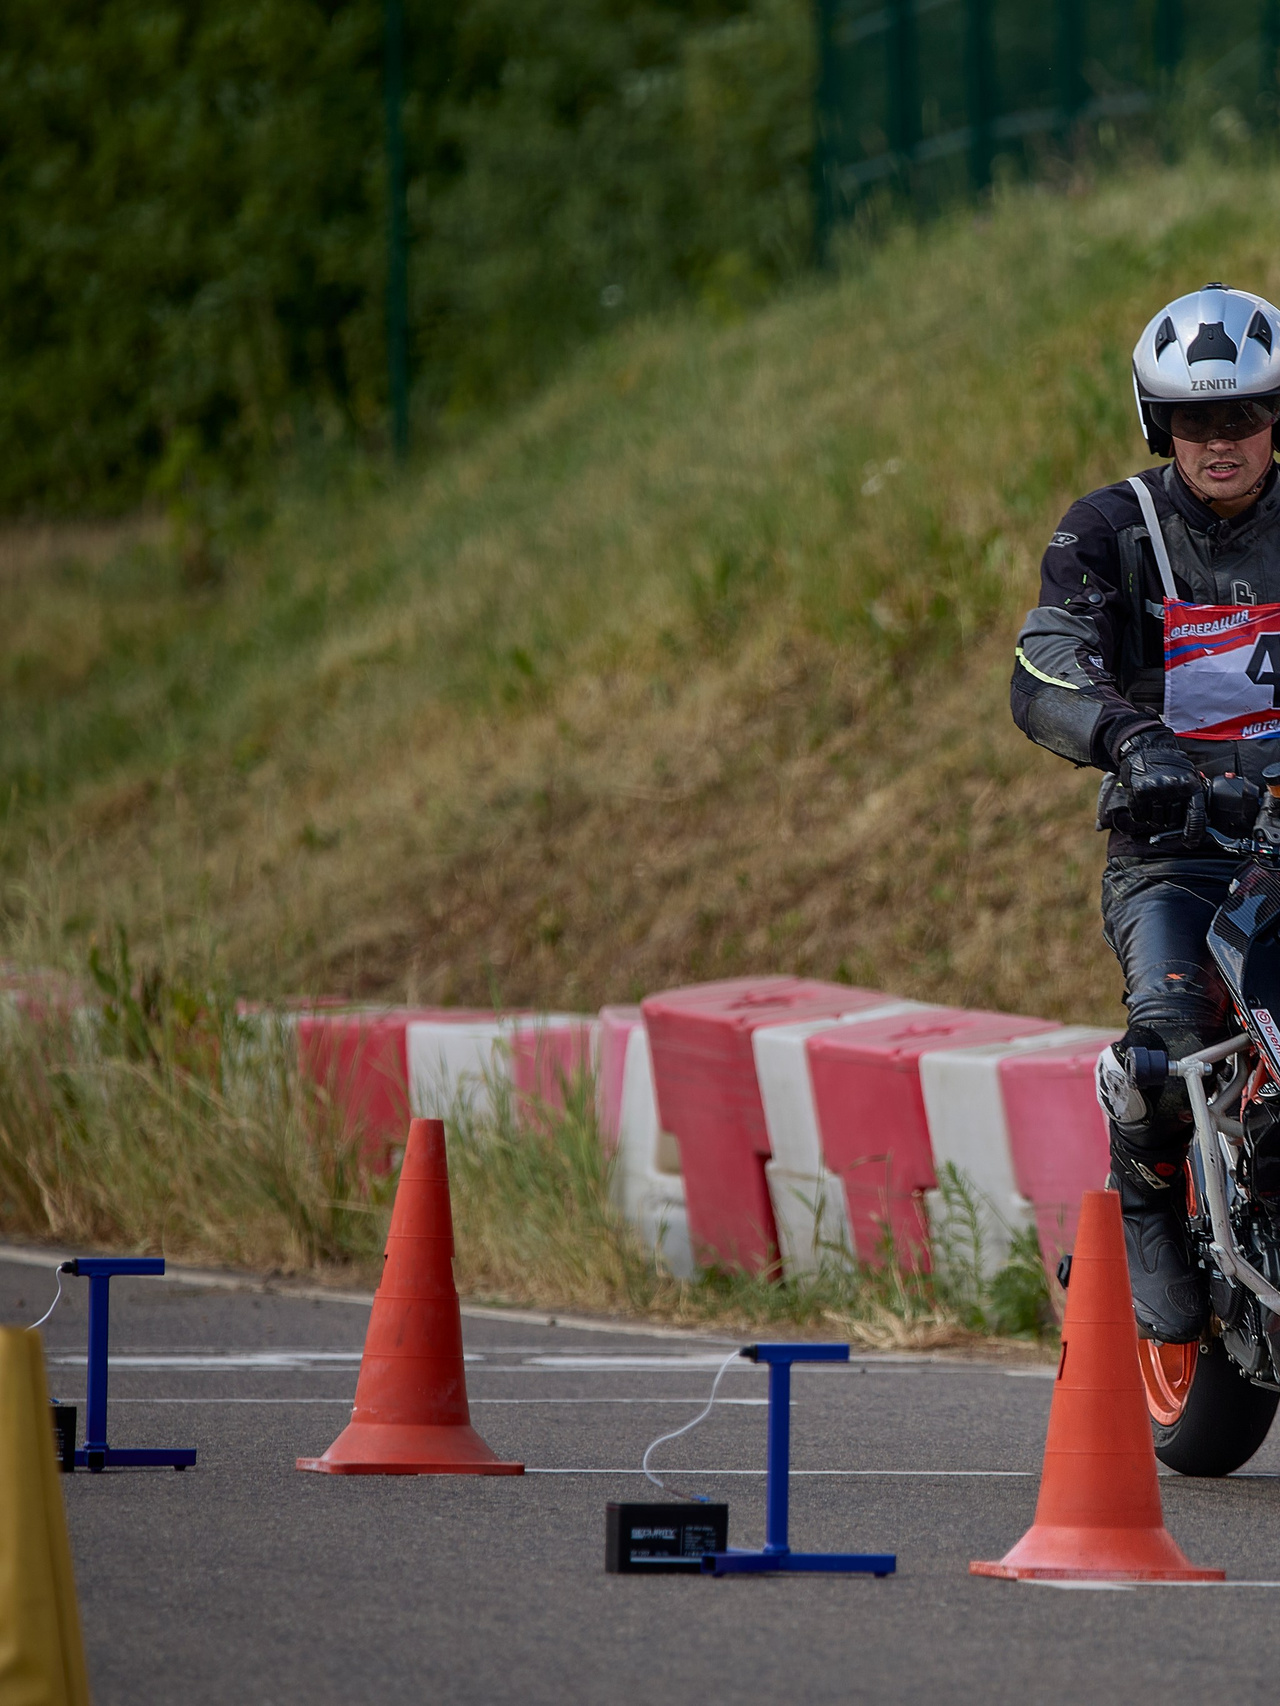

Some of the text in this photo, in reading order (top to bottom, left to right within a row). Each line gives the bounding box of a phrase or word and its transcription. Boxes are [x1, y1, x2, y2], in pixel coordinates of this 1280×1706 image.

[1190, 377, 1238, 392] ZENITH
[1170, 609, 1250, 639] ФЕДЕРАЦИЯ
[630, 1528, 676, 1539] SECURITY
